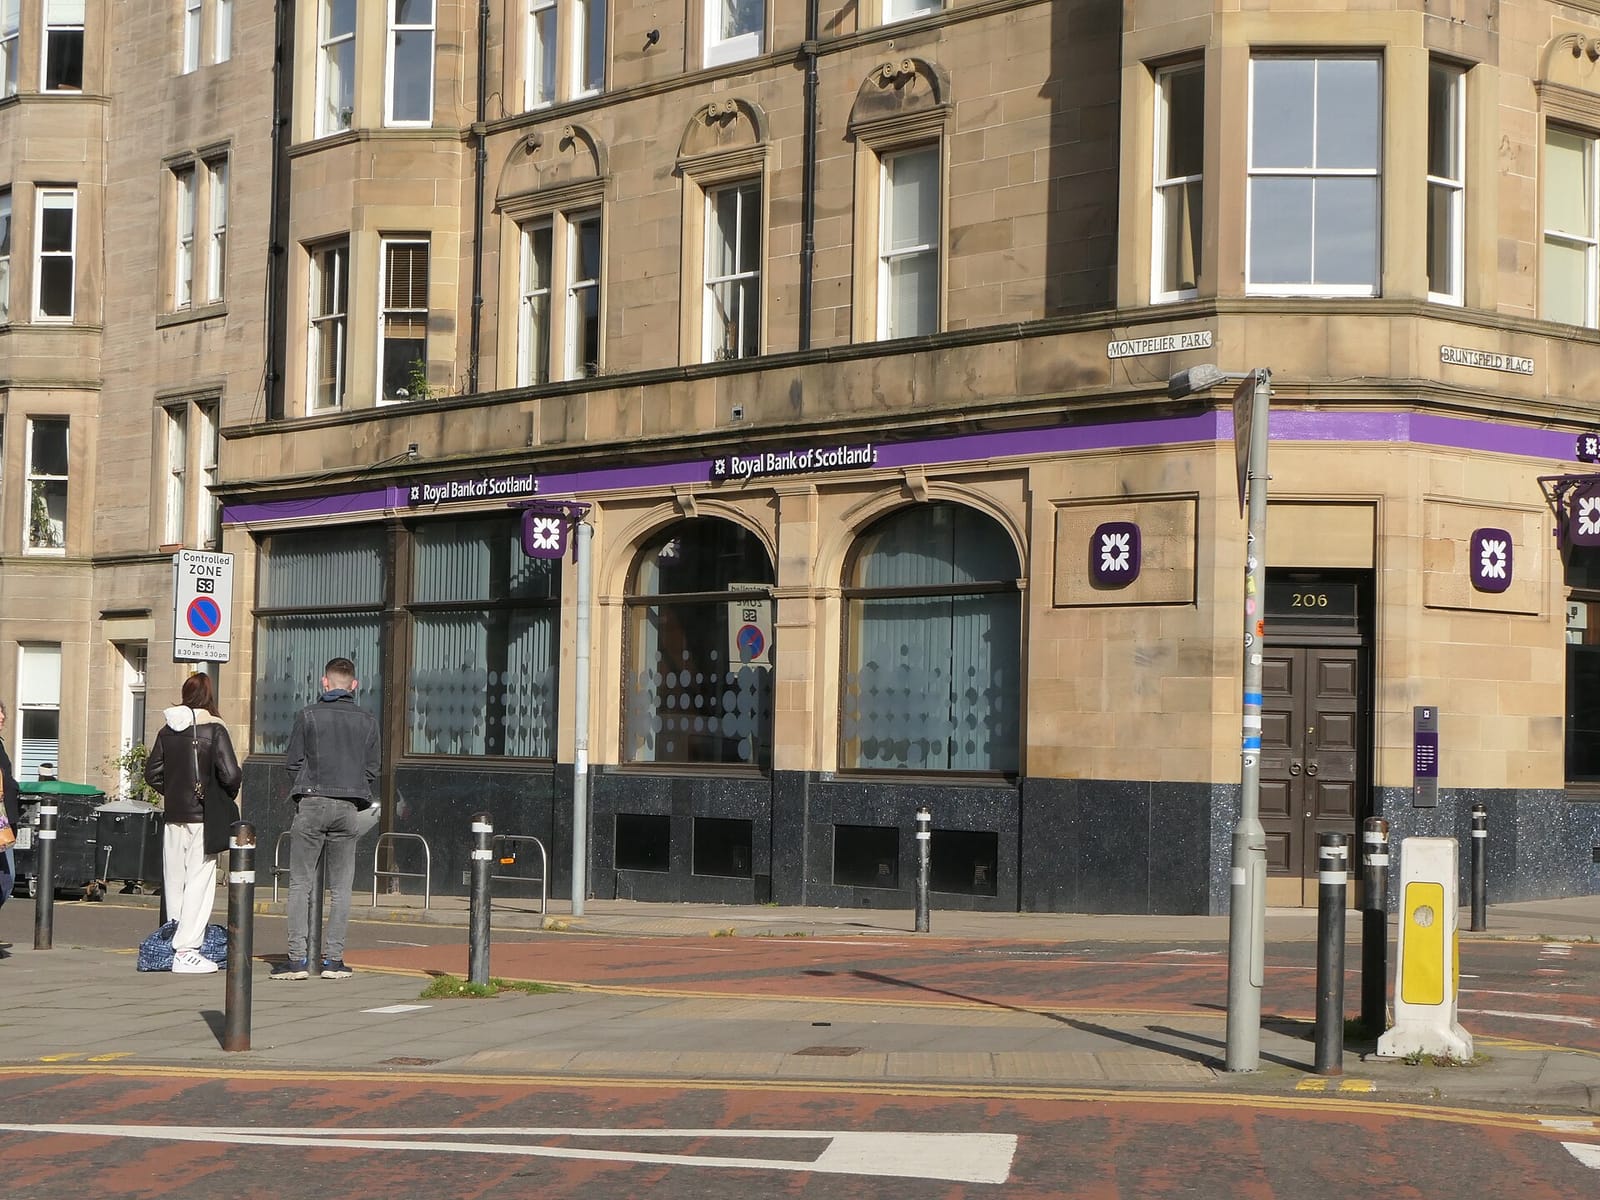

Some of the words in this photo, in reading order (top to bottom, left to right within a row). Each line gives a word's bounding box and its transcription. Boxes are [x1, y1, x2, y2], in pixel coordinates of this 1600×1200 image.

[1110, 337, 1176, 356] MONTPELIER
[1181, 332, 1210, 348] PARK
[1443, 348, 1503, 369] BRUNTSFIELD
[1505, 357, 1533, 373] PLACE
[731, 454, 764, 478] Royal
[766, 450, 798, 472] Bank
[799, 448, 814, 469] of
[815, 444, 871, 467] Scotland
[423, 482, 450, 503] Royal
[451, 478, 476, 496] Bank
[476, 478, 489, 495] of
[488, 474, 533, 494] Scotland
[183, 552, 230, 565] Controlled
[189, 565, 222, 576] ZONE
[198, 580, 213, 592] S3
[1291, 593, 1328, 607] 206
